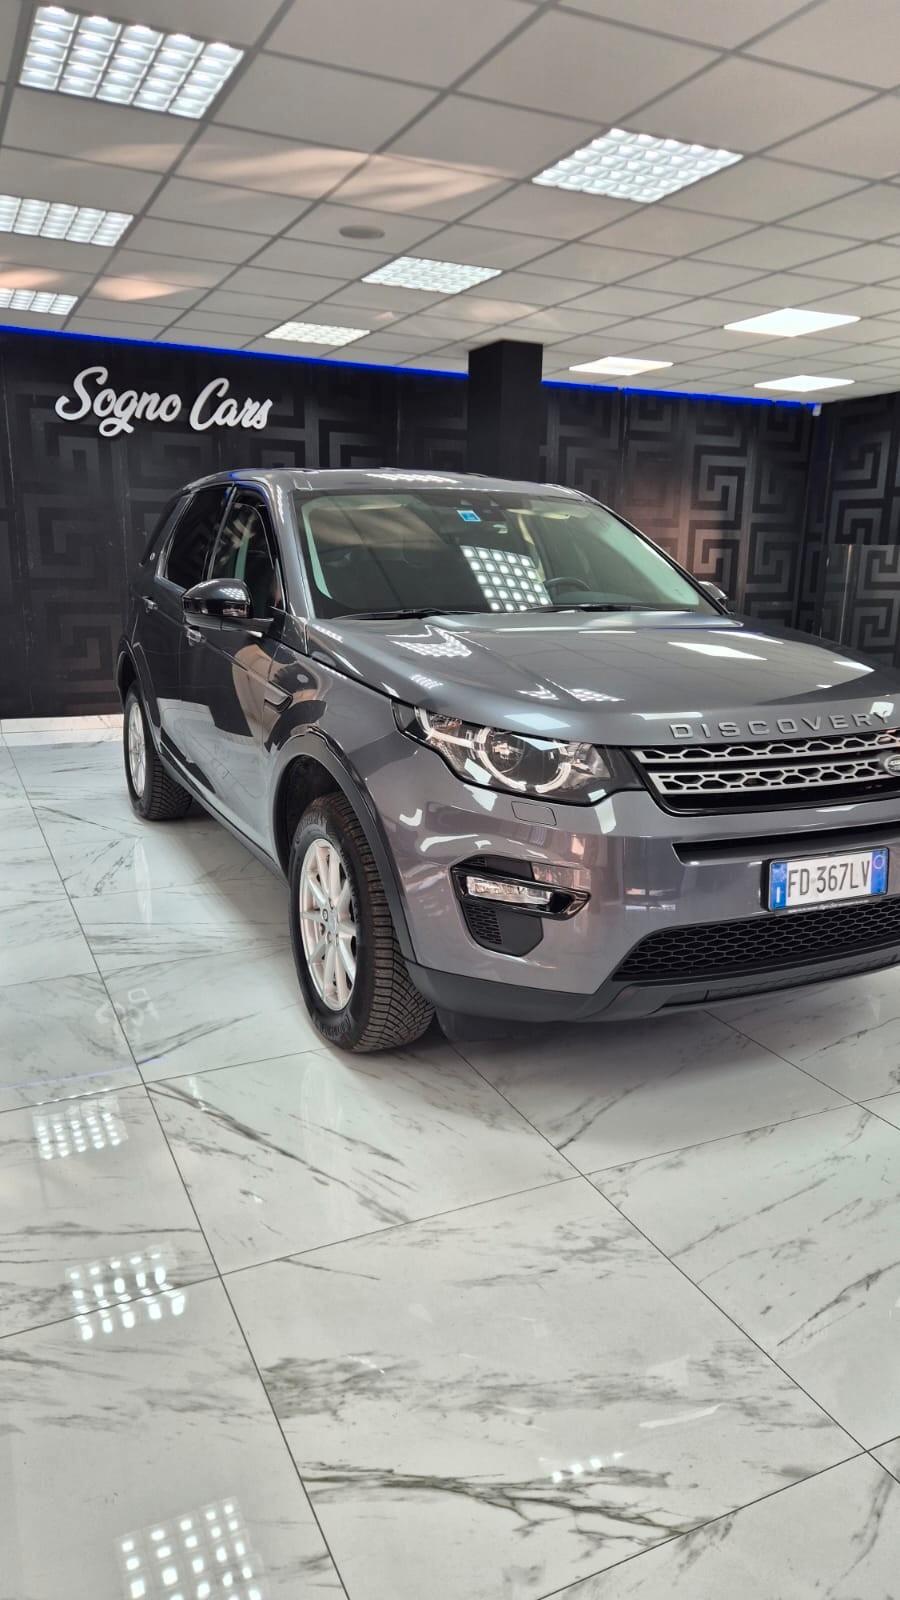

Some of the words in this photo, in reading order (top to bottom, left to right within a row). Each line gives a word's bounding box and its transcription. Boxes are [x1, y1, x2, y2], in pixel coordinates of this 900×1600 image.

[55, 366, 182, 437] Sogno
[189, 377, 273, 431] Cars
[669, 710, 890, 739] DISCOVERY
[788, 868, 810, 898] FD
[816, 860, 870, 894] 367LV
